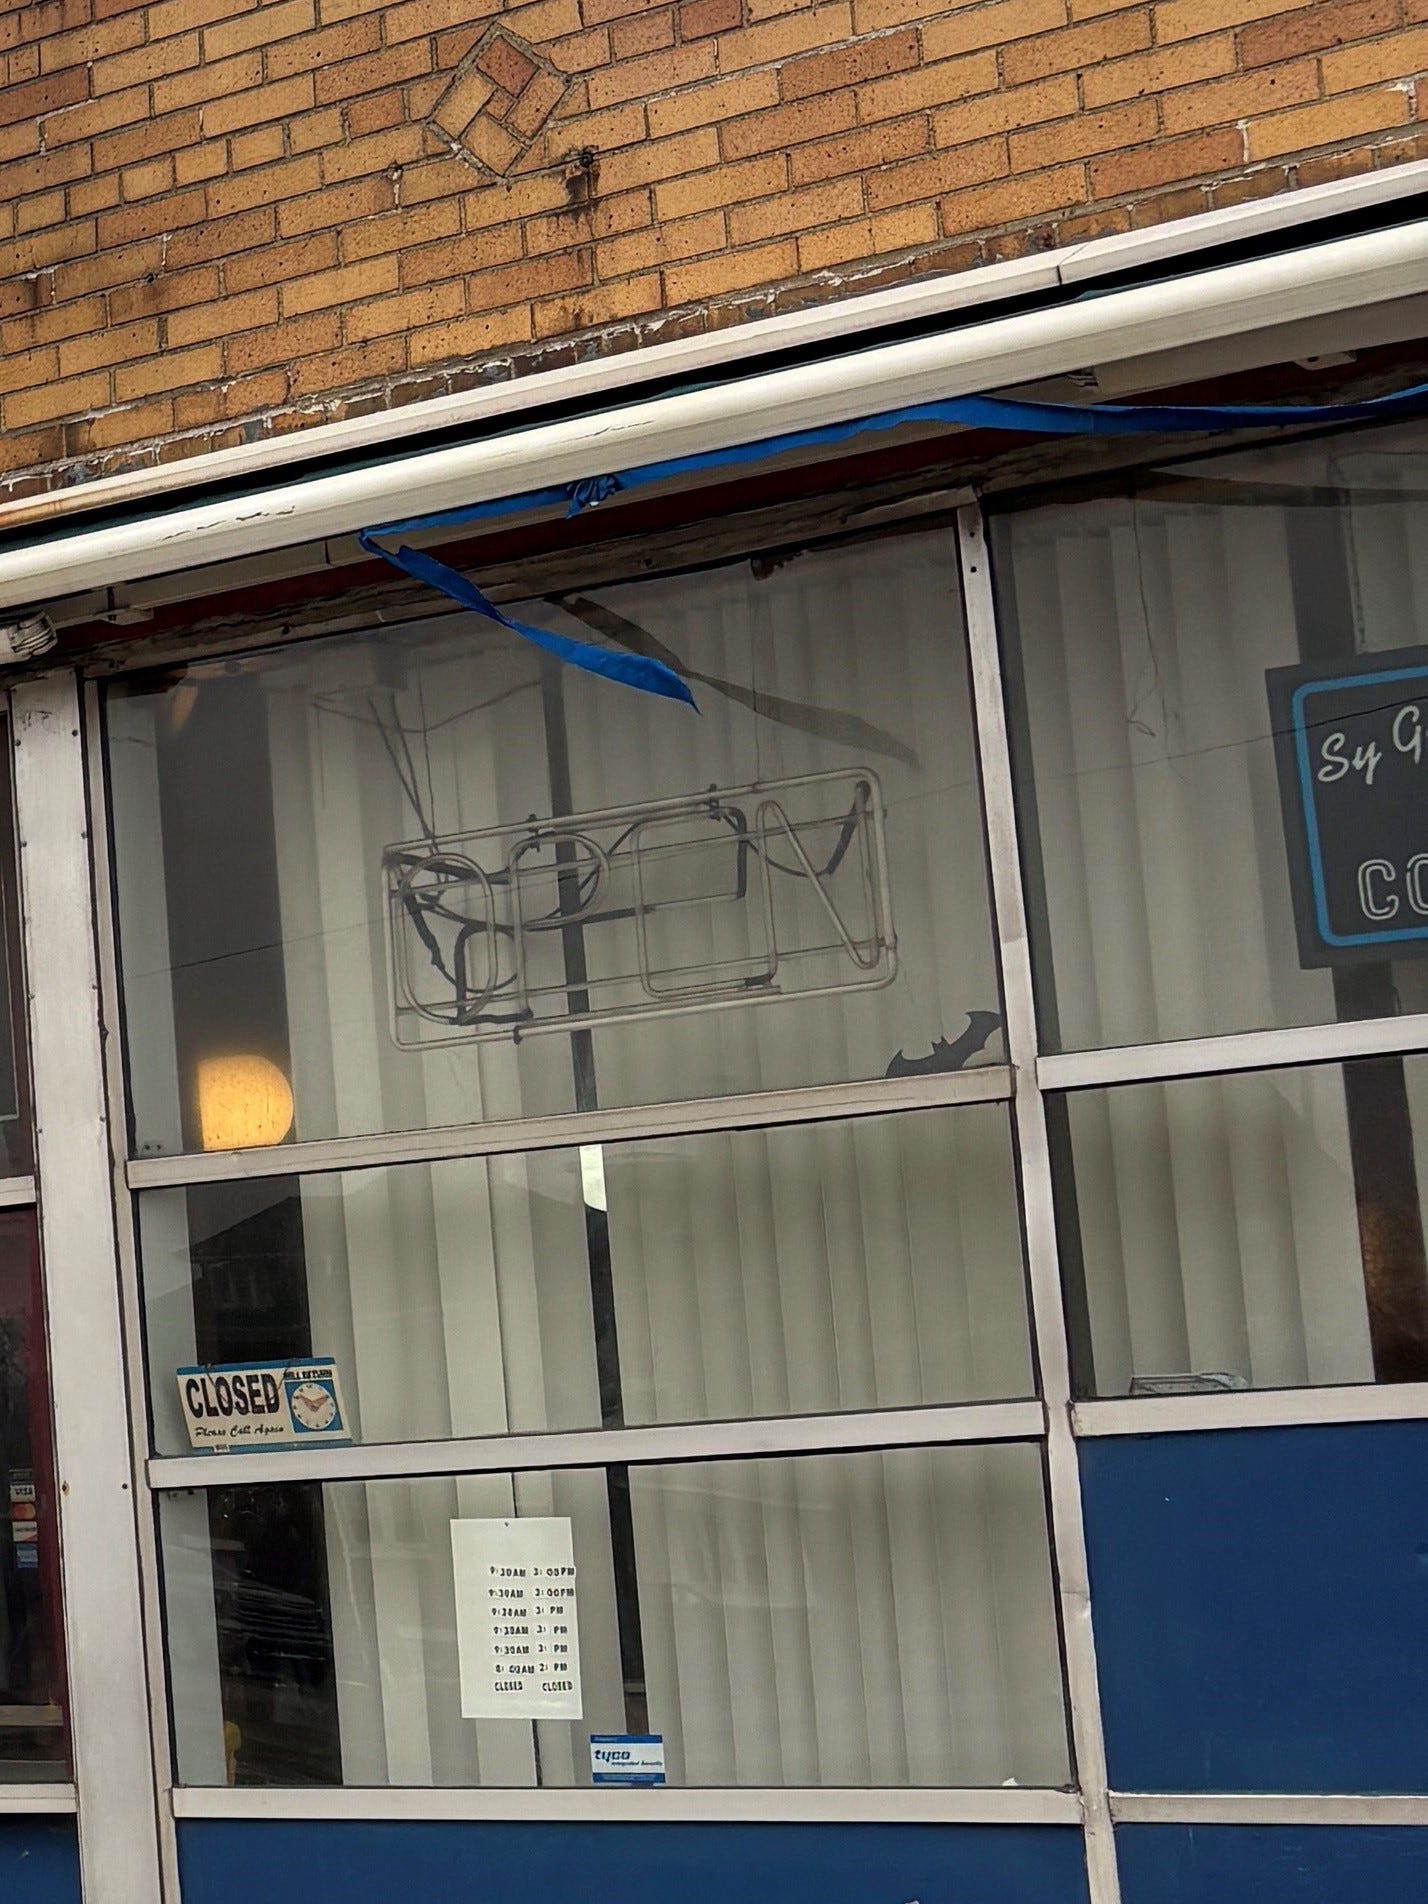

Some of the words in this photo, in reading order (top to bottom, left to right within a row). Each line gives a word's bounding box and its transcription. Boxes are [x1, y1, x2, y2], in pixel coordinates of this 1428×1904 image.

[1317, 732, 1381, 785] Sy
[1392, 705, 1428, 764] G
[186, 1373, 280, 1418] CLOSED
